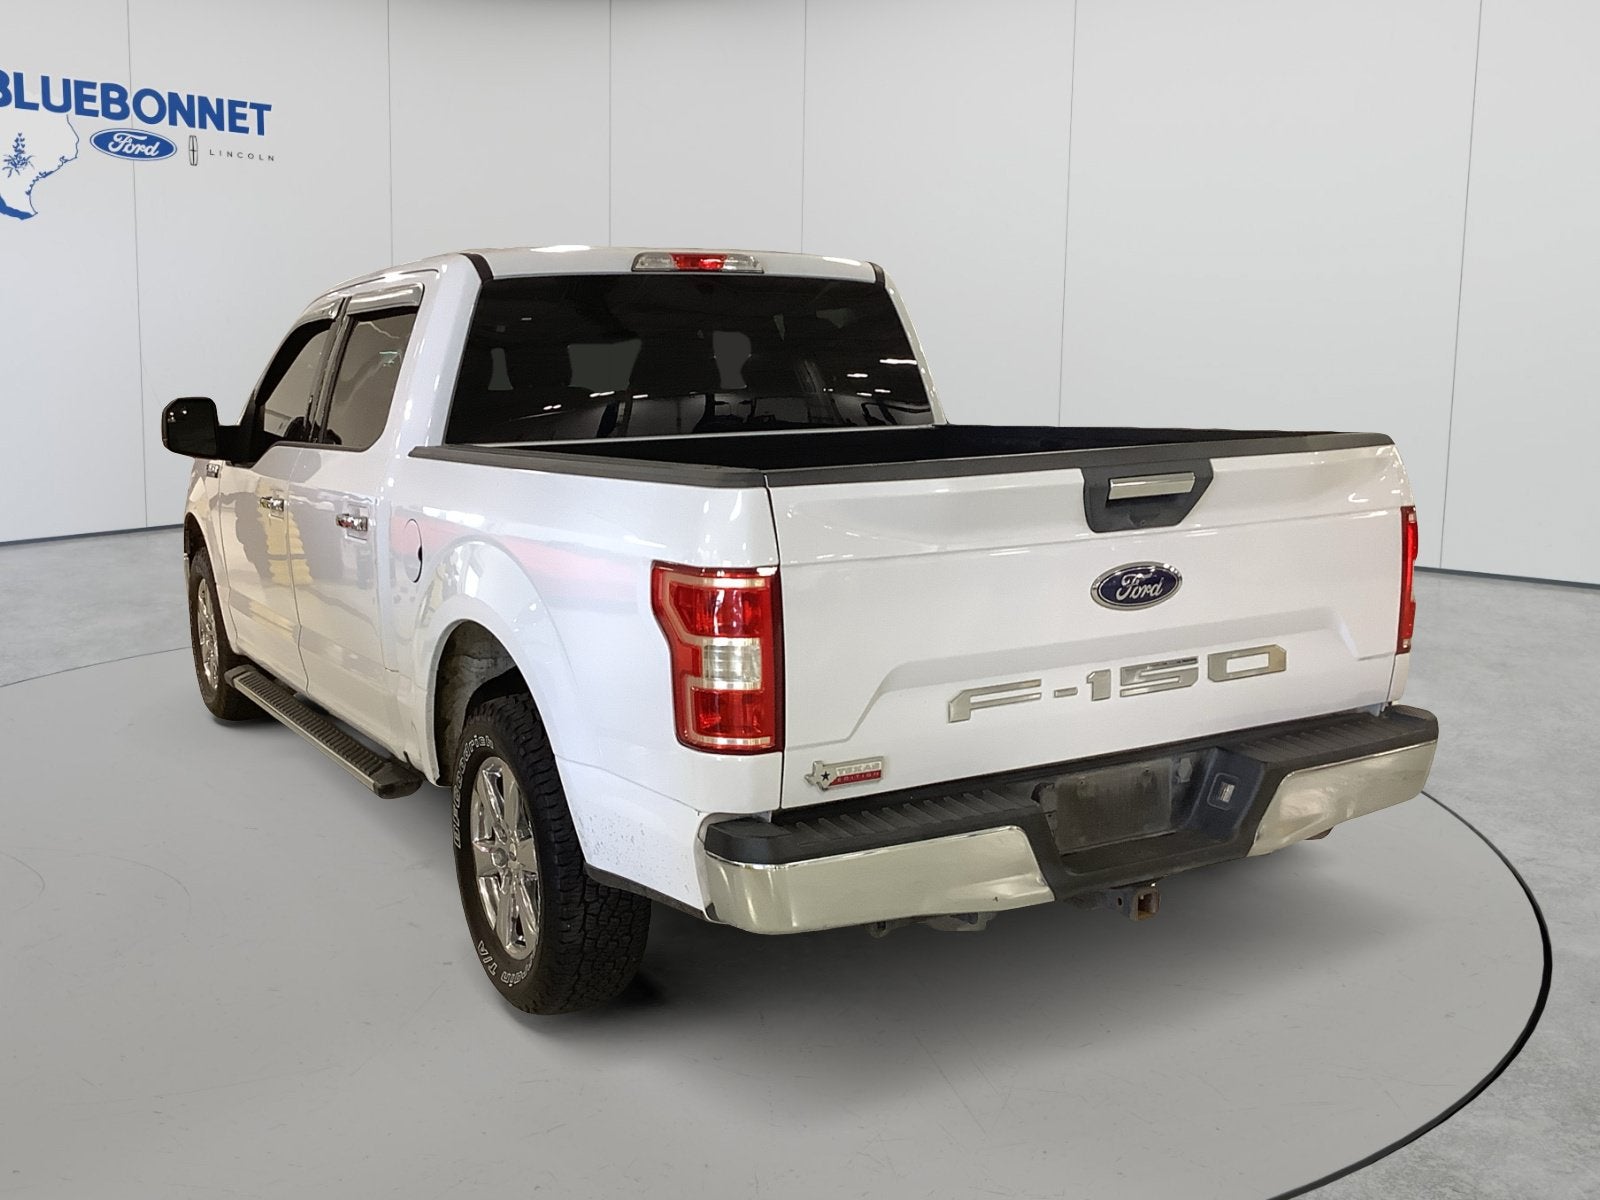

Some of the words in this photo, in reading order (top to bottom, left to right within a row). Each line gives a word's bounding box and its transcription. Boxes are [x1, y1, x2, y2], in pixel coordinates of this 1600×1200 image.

[108, 132, 160, 157] Ford
[209, 148, 275, 162] LINCOLN
[1116, 573, 1163, 601] Ford
[947, 644, 1287, 723] F-150
[837, 762, 880, 775] TEXAS
